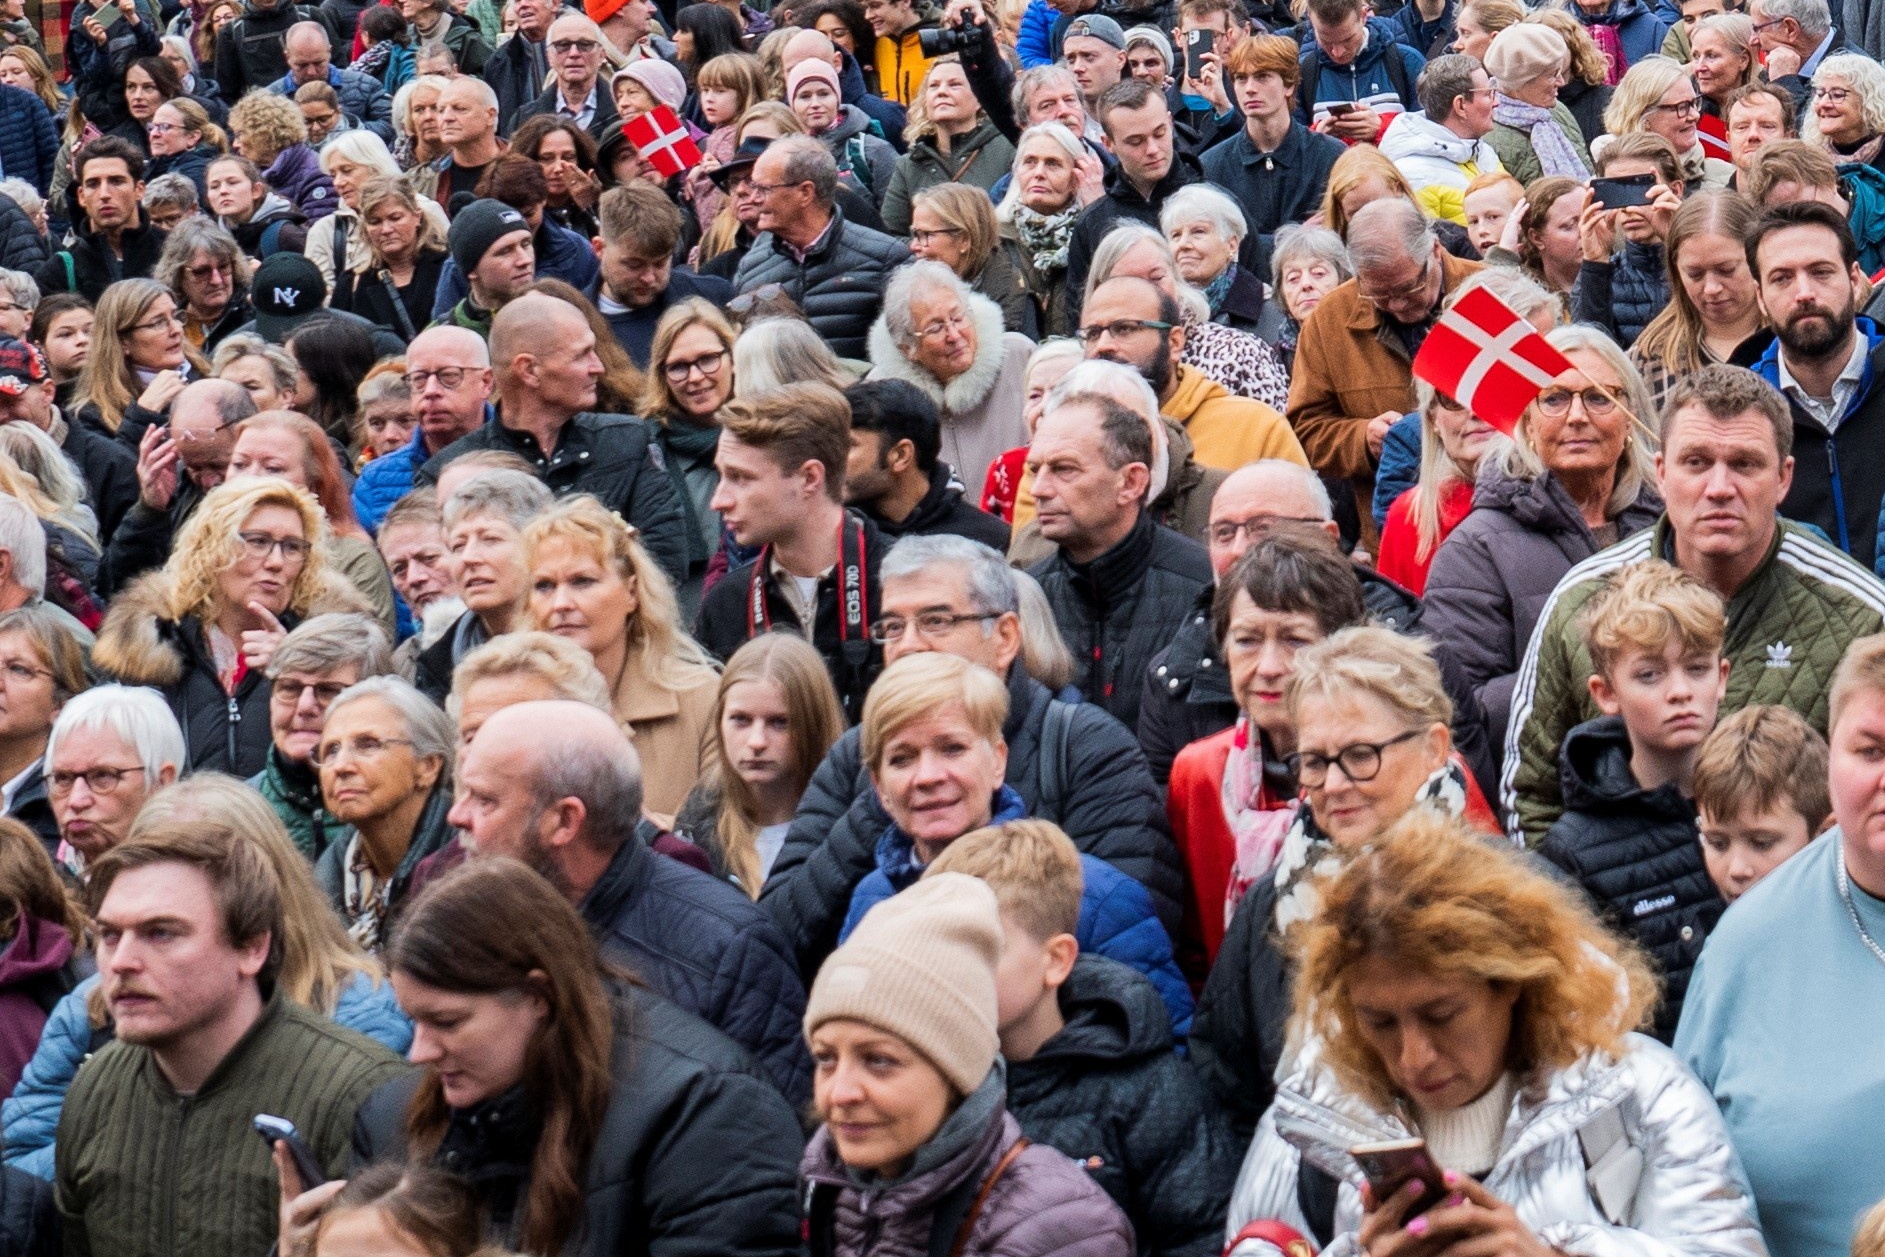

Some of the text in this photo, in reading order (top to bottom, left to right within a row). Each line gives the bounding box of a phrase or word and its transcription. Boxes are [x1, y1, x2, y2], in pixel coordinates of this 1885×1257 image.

[274, 287, 301, 307] NY
[846, 590, 861, 625] EOS
[1633, 894, 1676, 916] ellesse
